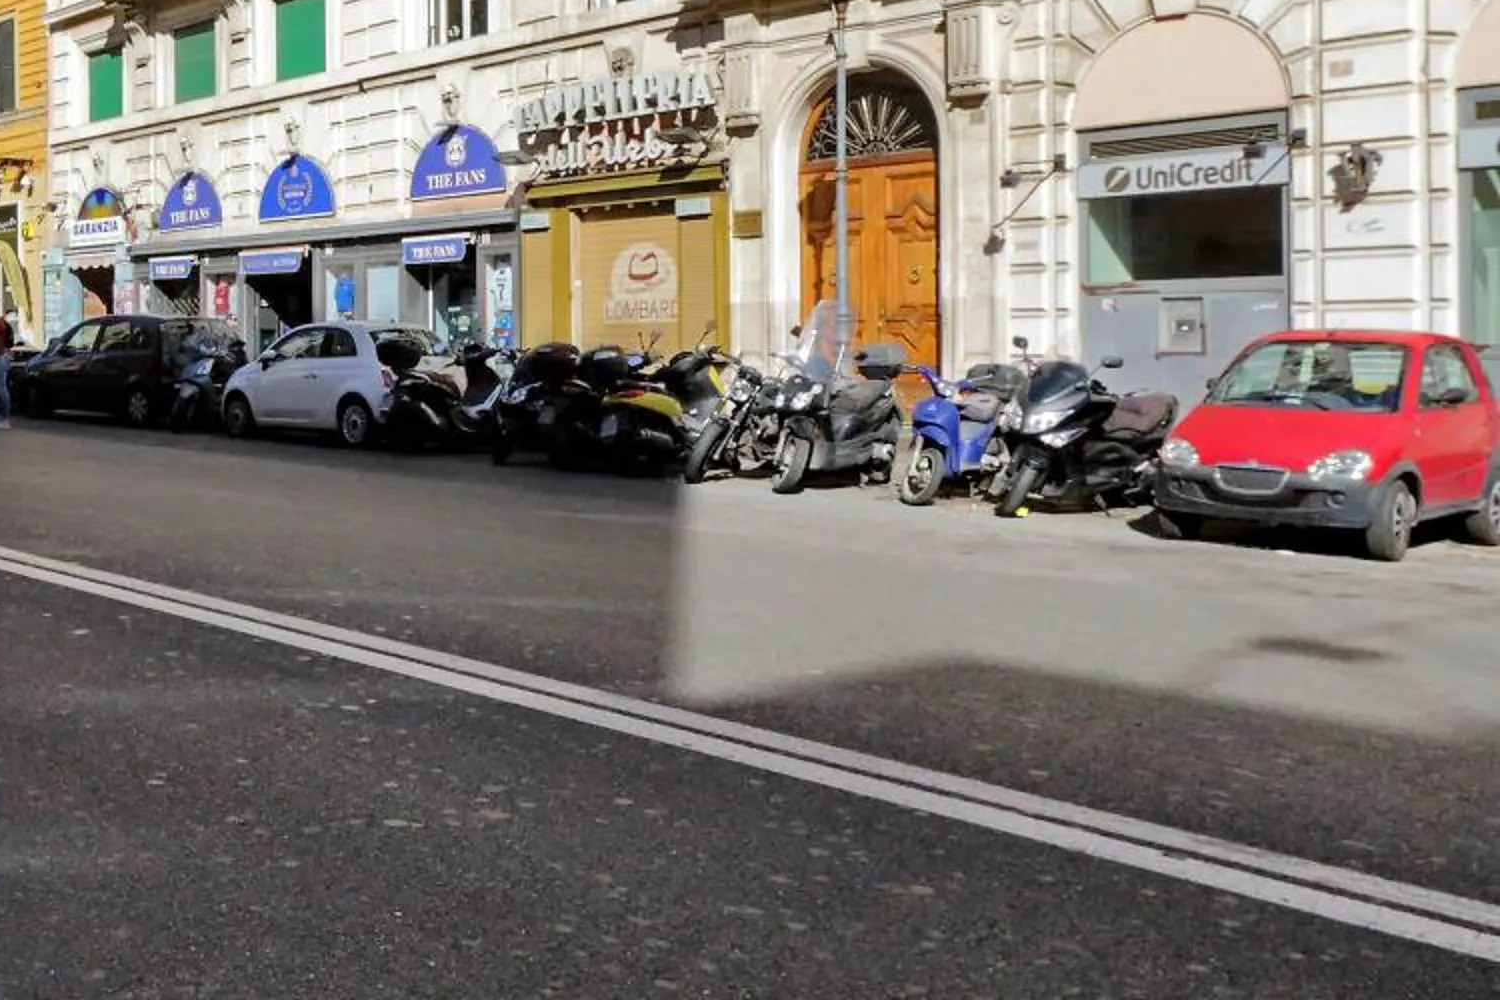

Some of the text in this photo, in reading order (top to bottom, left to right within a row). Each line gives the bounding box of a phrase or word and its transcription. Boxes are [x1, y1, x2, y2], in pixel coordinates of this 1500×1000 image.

[426, 169, 486, 190] THE FANS
[1136, 158, 1253, 190] UniCredit
